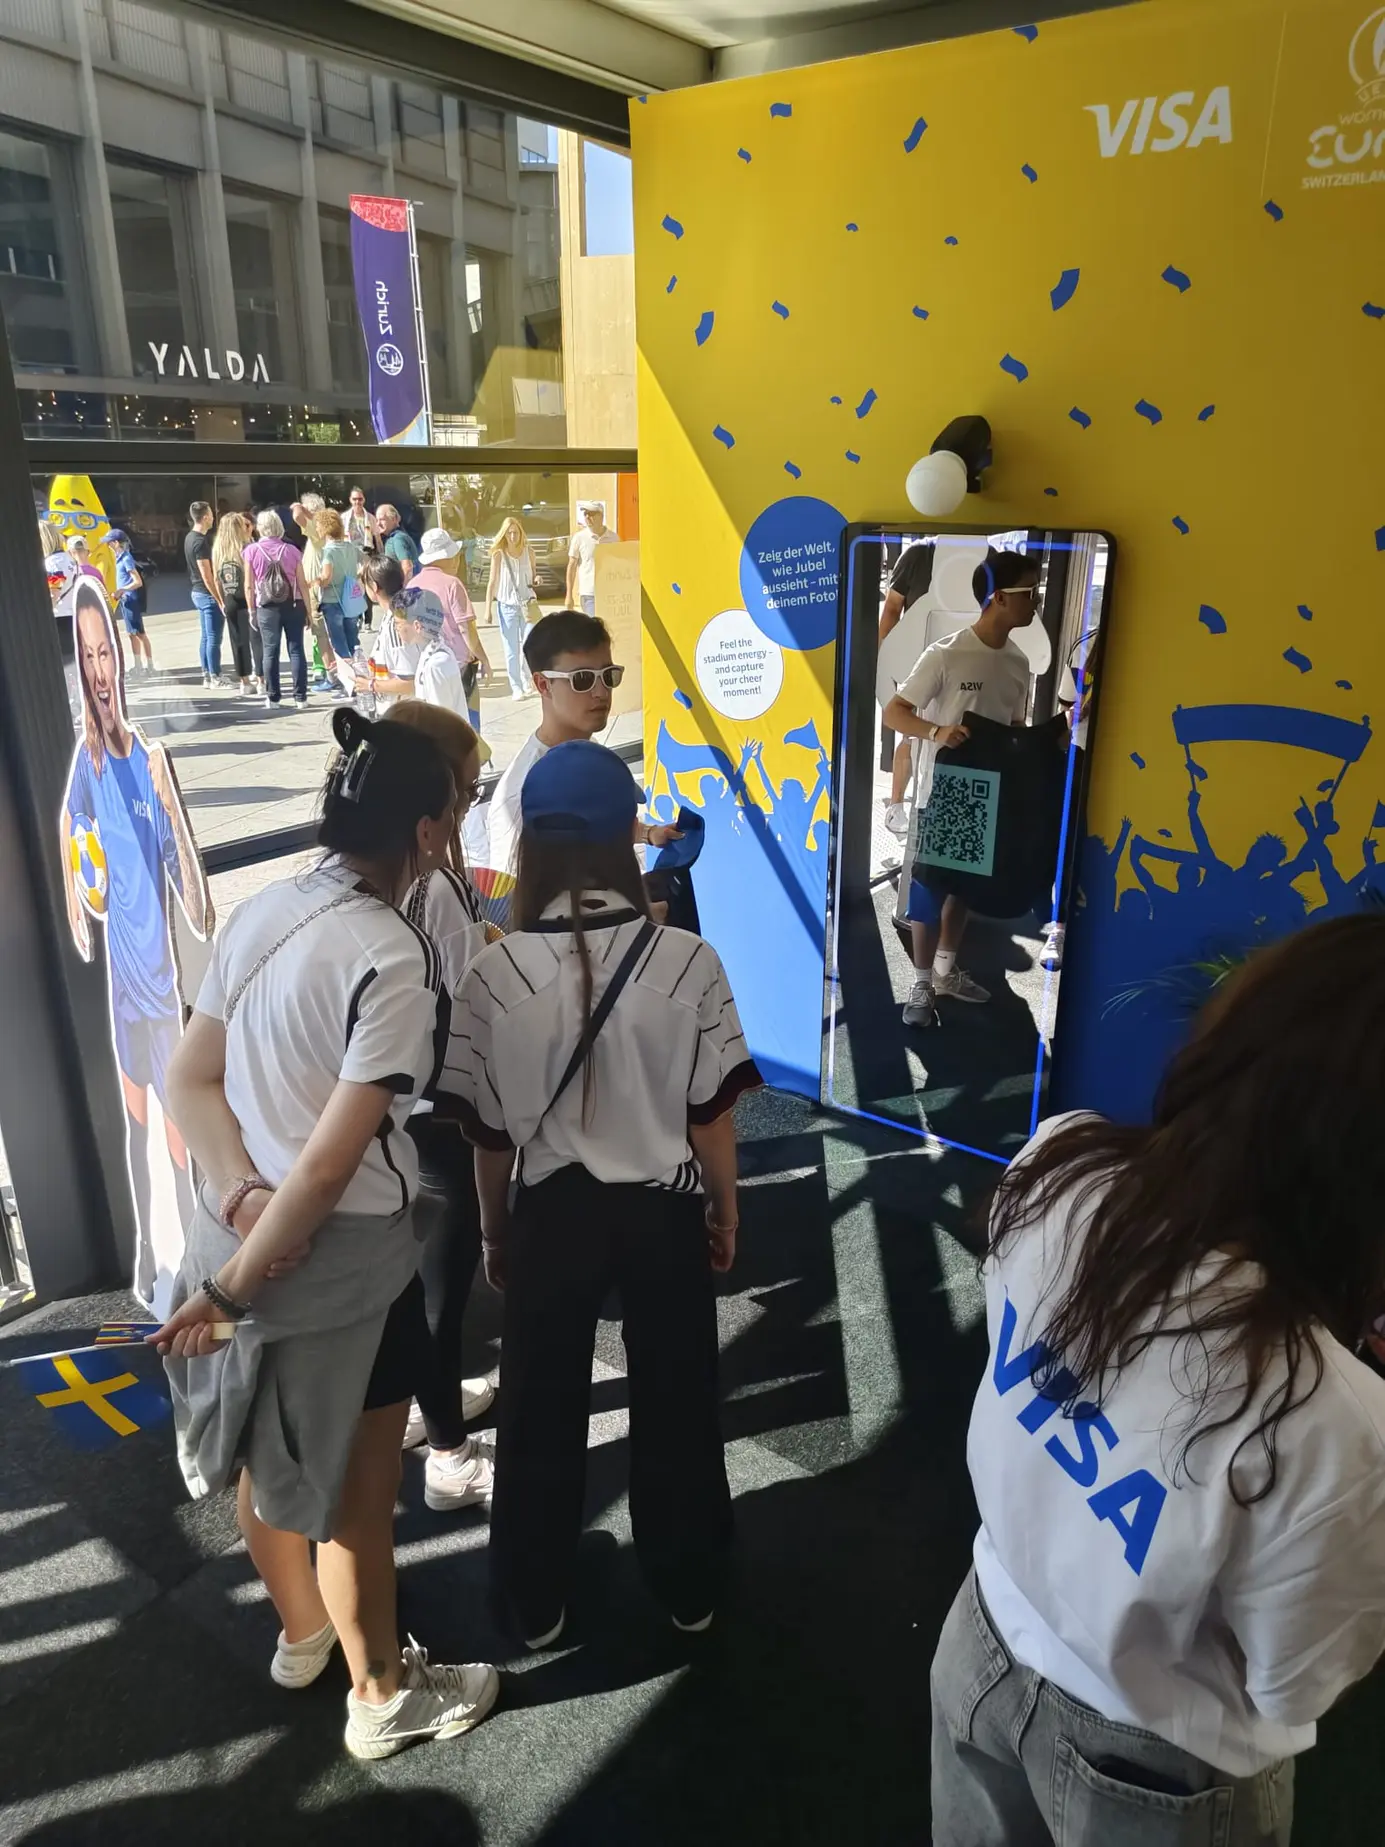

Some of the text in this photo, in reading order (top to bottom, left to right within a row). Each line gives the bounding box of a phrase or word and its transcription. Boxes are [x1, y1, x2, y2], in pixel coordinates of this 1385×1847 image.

[1082, 86, 1232, 158] VISA
[148, 341, 270, 383] YALDA
[758, 541, 836, 564] Zeig der Welt,
[772, 559, 827, 577] wie Jubel
[762, 577, 809, 595] aussieht
[819, 574, 838, 587] mit
[766, 594, 808, 610] deinem
[719, 638, 753, 650] Feel the
[703, 652, 737, 664] stadium
[737, 650, 767, 664] energy
[714, 661, 764, 675] and capture
[718, 674, 763, 688] your cheer
[723, 686, 762, 698] moment!
[993, 1285, 1168, 1577] VISA
